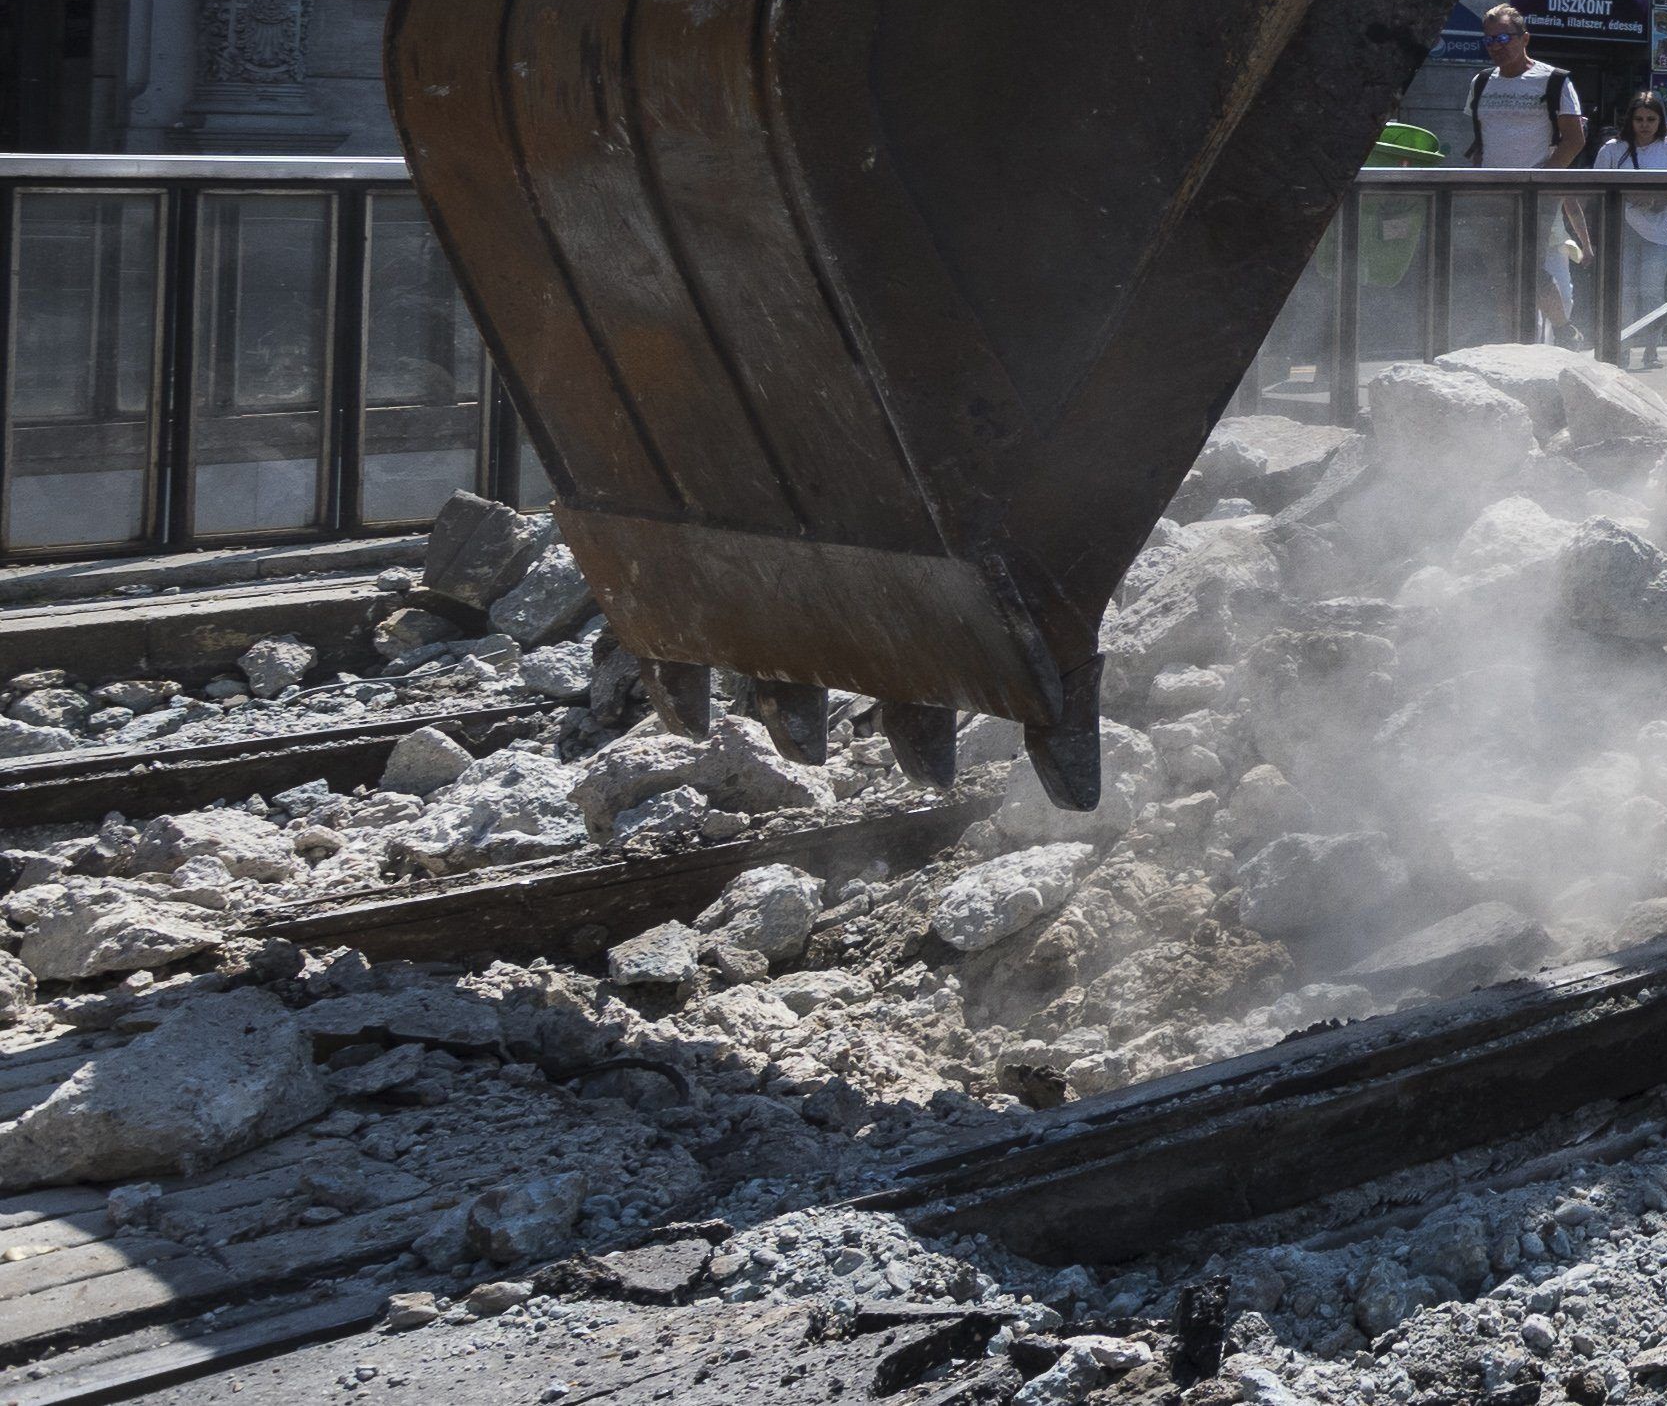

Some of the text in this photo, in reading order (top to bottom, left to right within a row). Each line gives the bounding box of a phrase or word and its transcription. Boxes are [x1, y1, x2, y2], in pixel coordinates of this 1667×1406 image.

[1522, 14, 1564, 29] rfüméria,
[1608, 19, 1644, 34] édesség
[1447, 40, 1481, 52] pepsi
